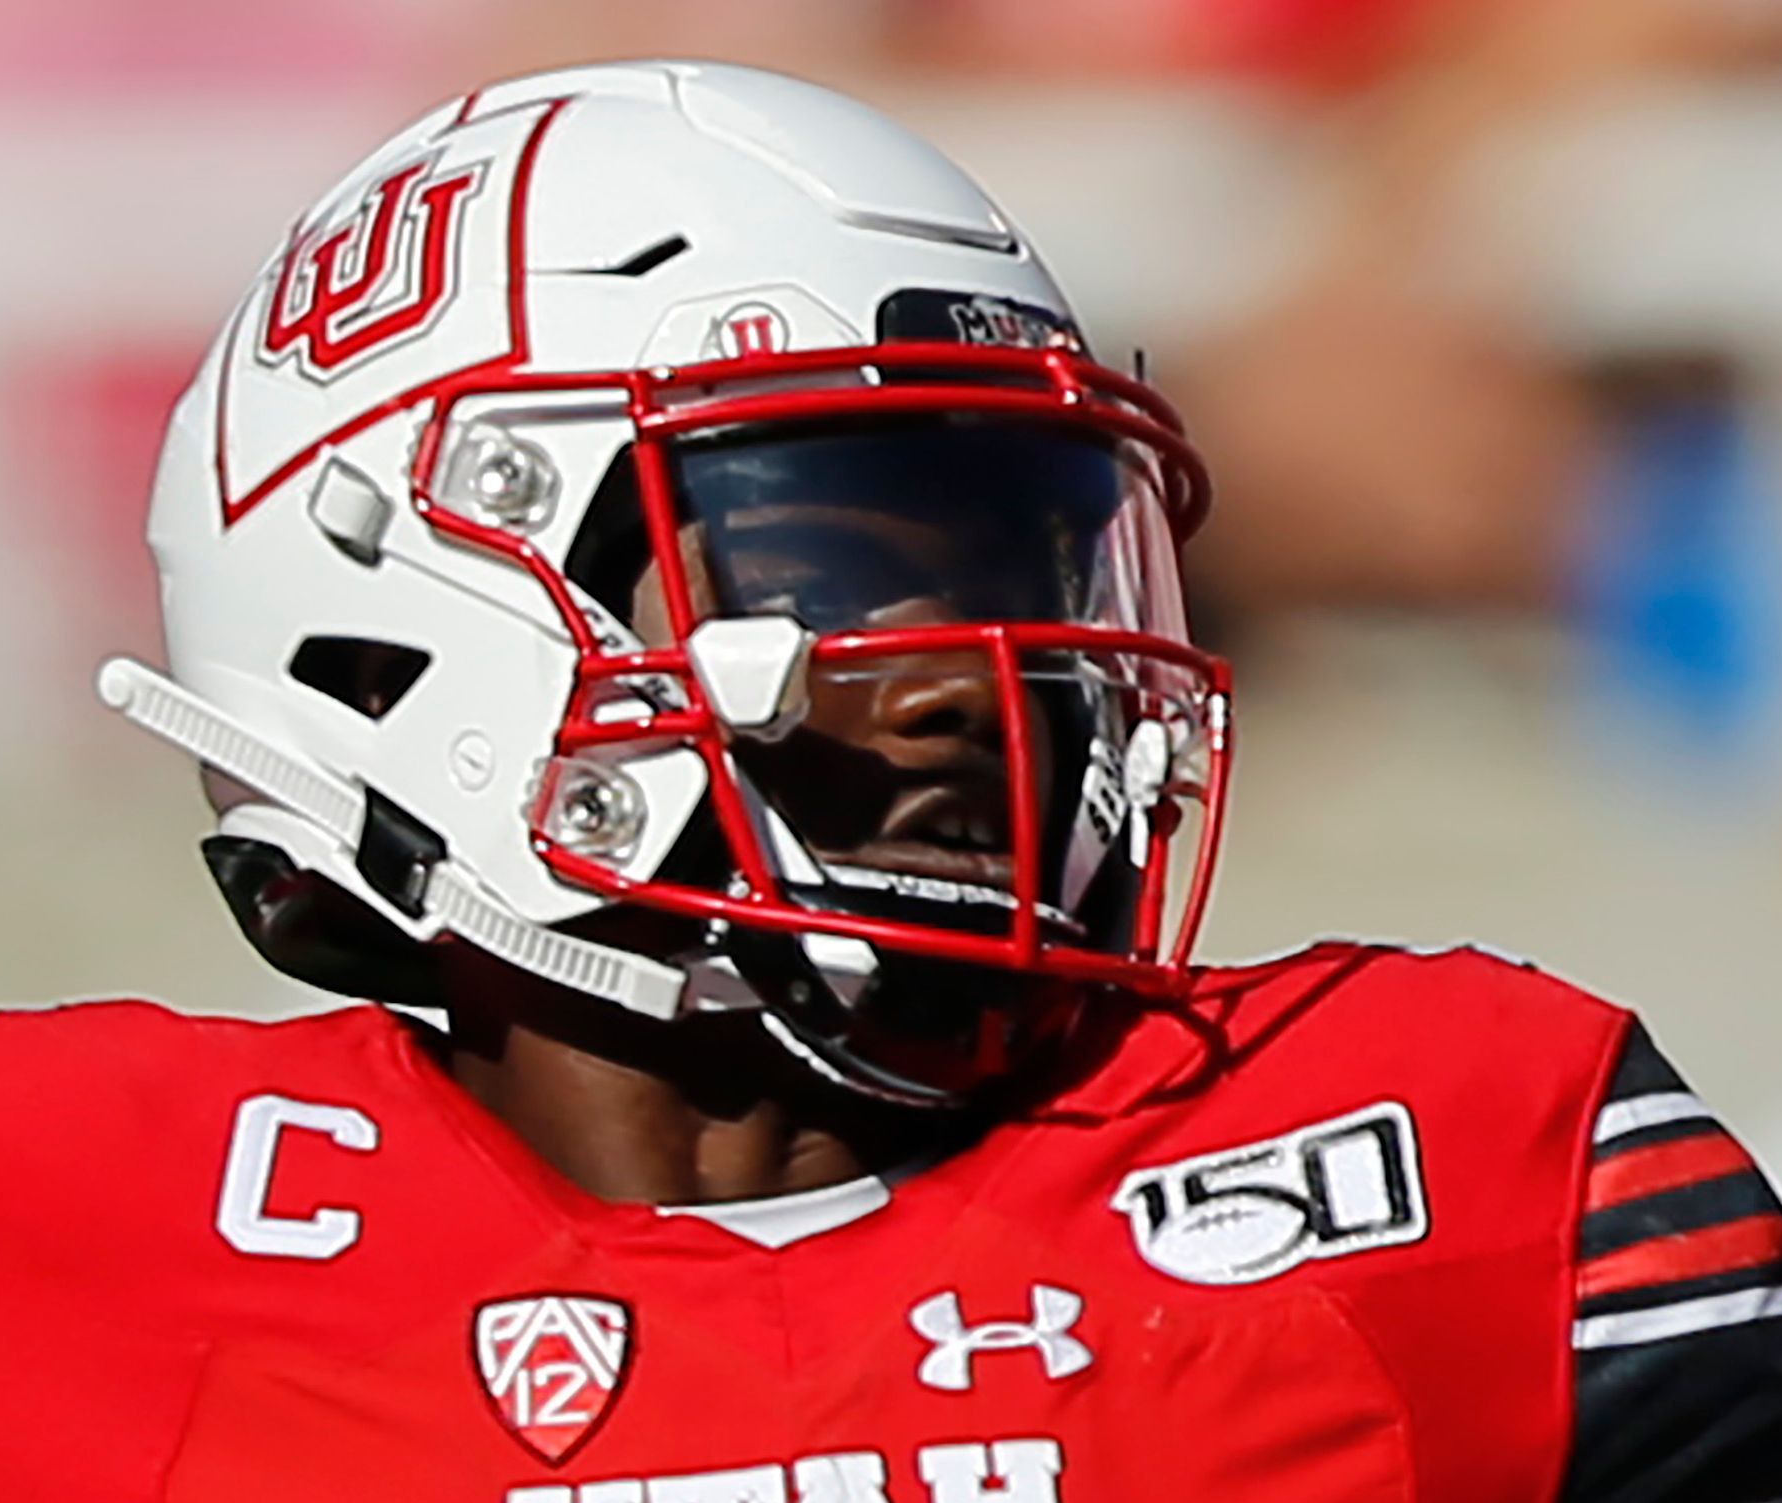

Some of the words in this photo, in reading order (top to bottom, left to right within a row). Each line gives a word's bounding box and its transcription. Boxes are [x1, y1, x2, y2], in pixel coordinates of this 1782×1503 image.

[216, 1094, 378, 1260] C
[1124, 1115, 1413, 1274] 150
[477, 1297, 627, 1397] PAC
[516, 1362, 593, 1427] 12
